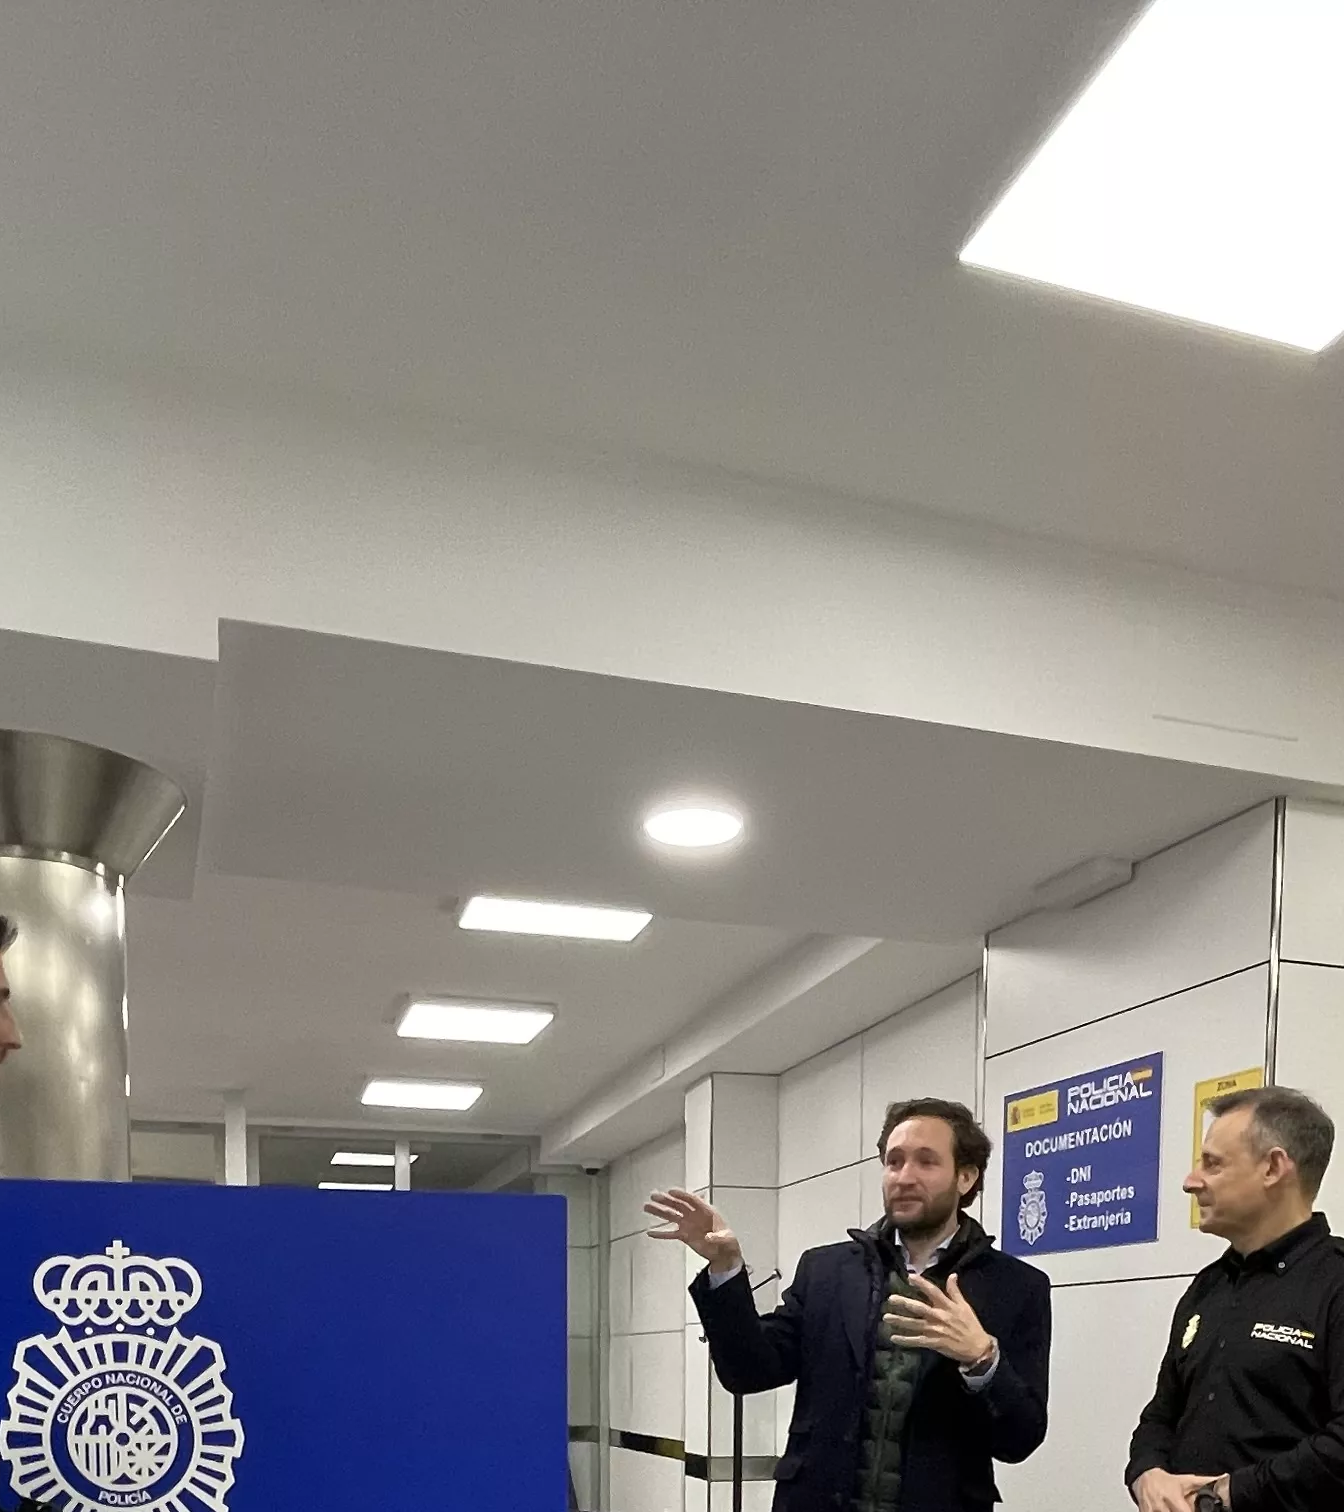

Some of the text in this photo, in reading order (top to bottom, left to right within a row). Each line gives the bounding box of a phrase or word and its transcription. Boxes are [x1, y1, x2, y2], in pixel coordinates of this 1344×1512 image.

[1067, 1071, 1134, 1103] POLICIA
[1067, 1083, 1153, 1116] NACIONAL
[1025, 1117, 1132, 1158] DOCUMENTACIÓN
[1064, 1185, 1135, 1208] -Pasaportes
[1250, 1330, 1313, 1349] NACIONAL
[57, 1372, 188, 1425] CUERPO NACIONAL DE
